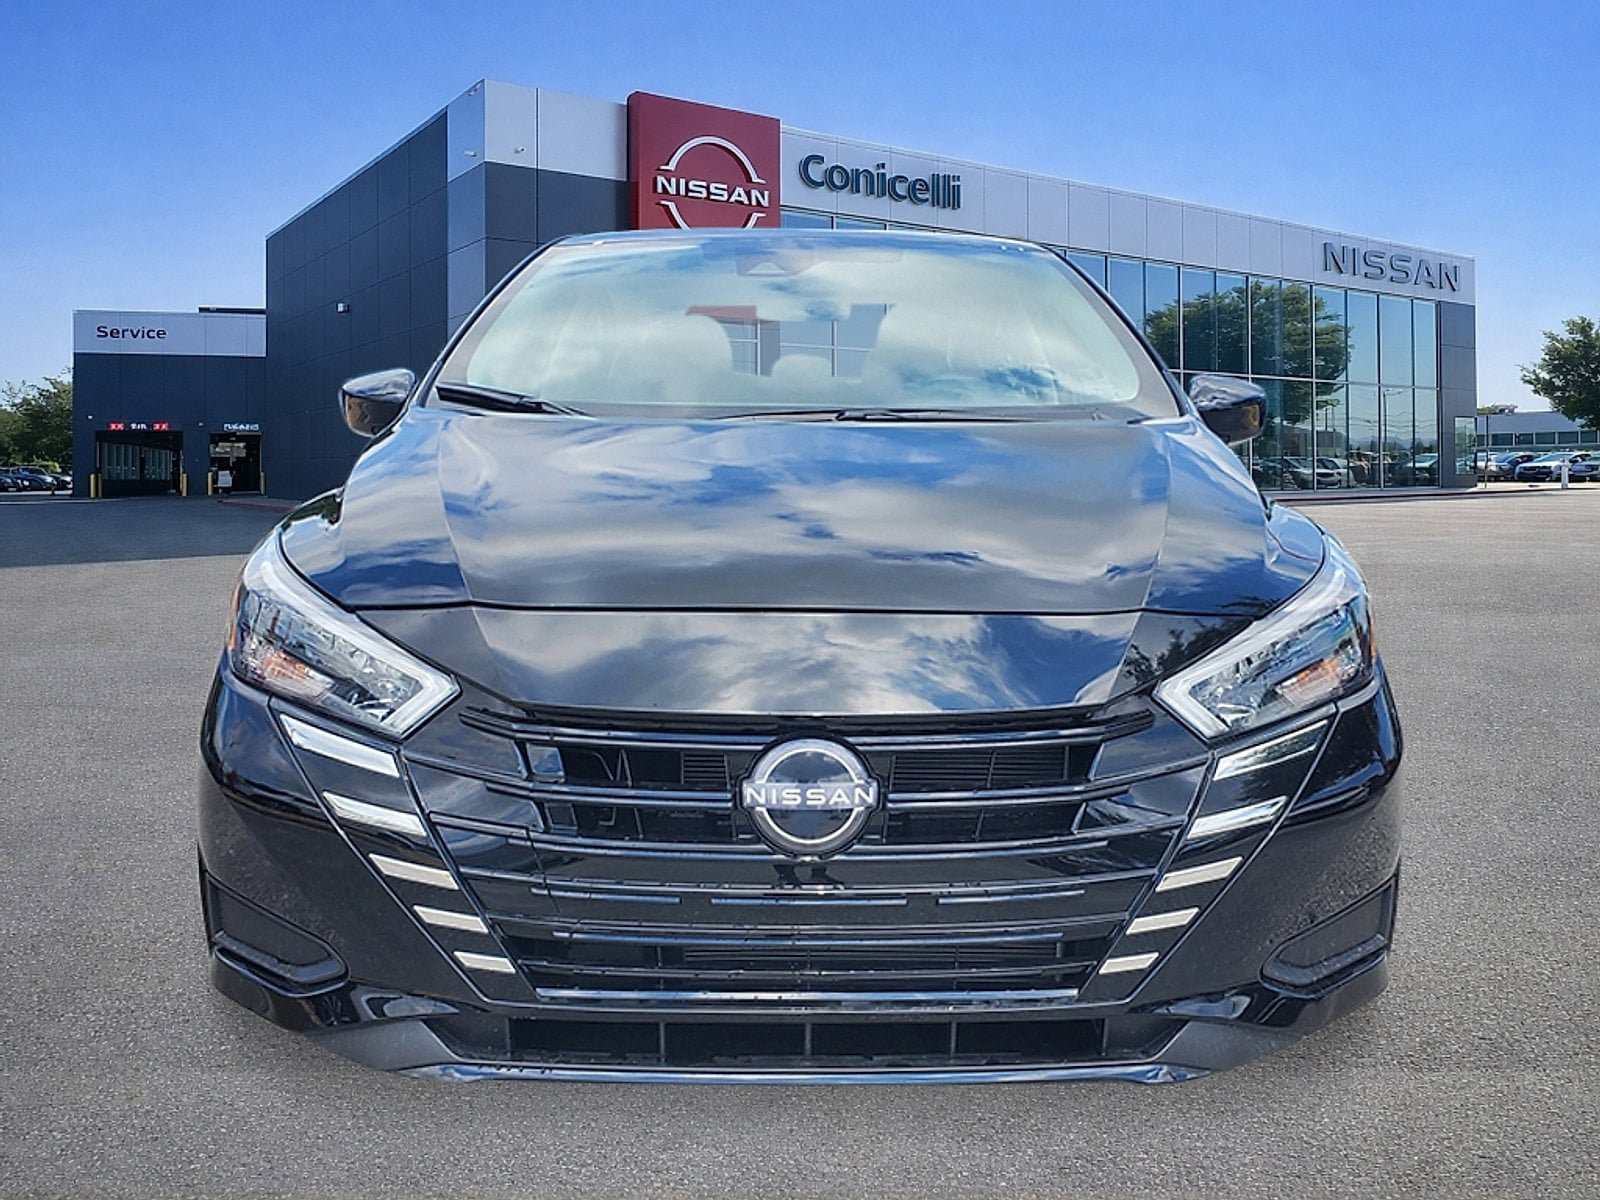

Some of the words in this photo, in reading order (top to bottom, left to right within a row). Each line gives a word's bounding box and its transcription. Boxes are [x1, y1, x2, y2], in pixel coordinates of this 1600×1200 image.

[655, 175, 769, 207] NISSAN
[800, 155, 961, 209] Conicelli
[1323, 242, 1461, 292] NISSAN
[96, 325, 167, 339] Service
[746, 787, 873, 805] NISSAN
